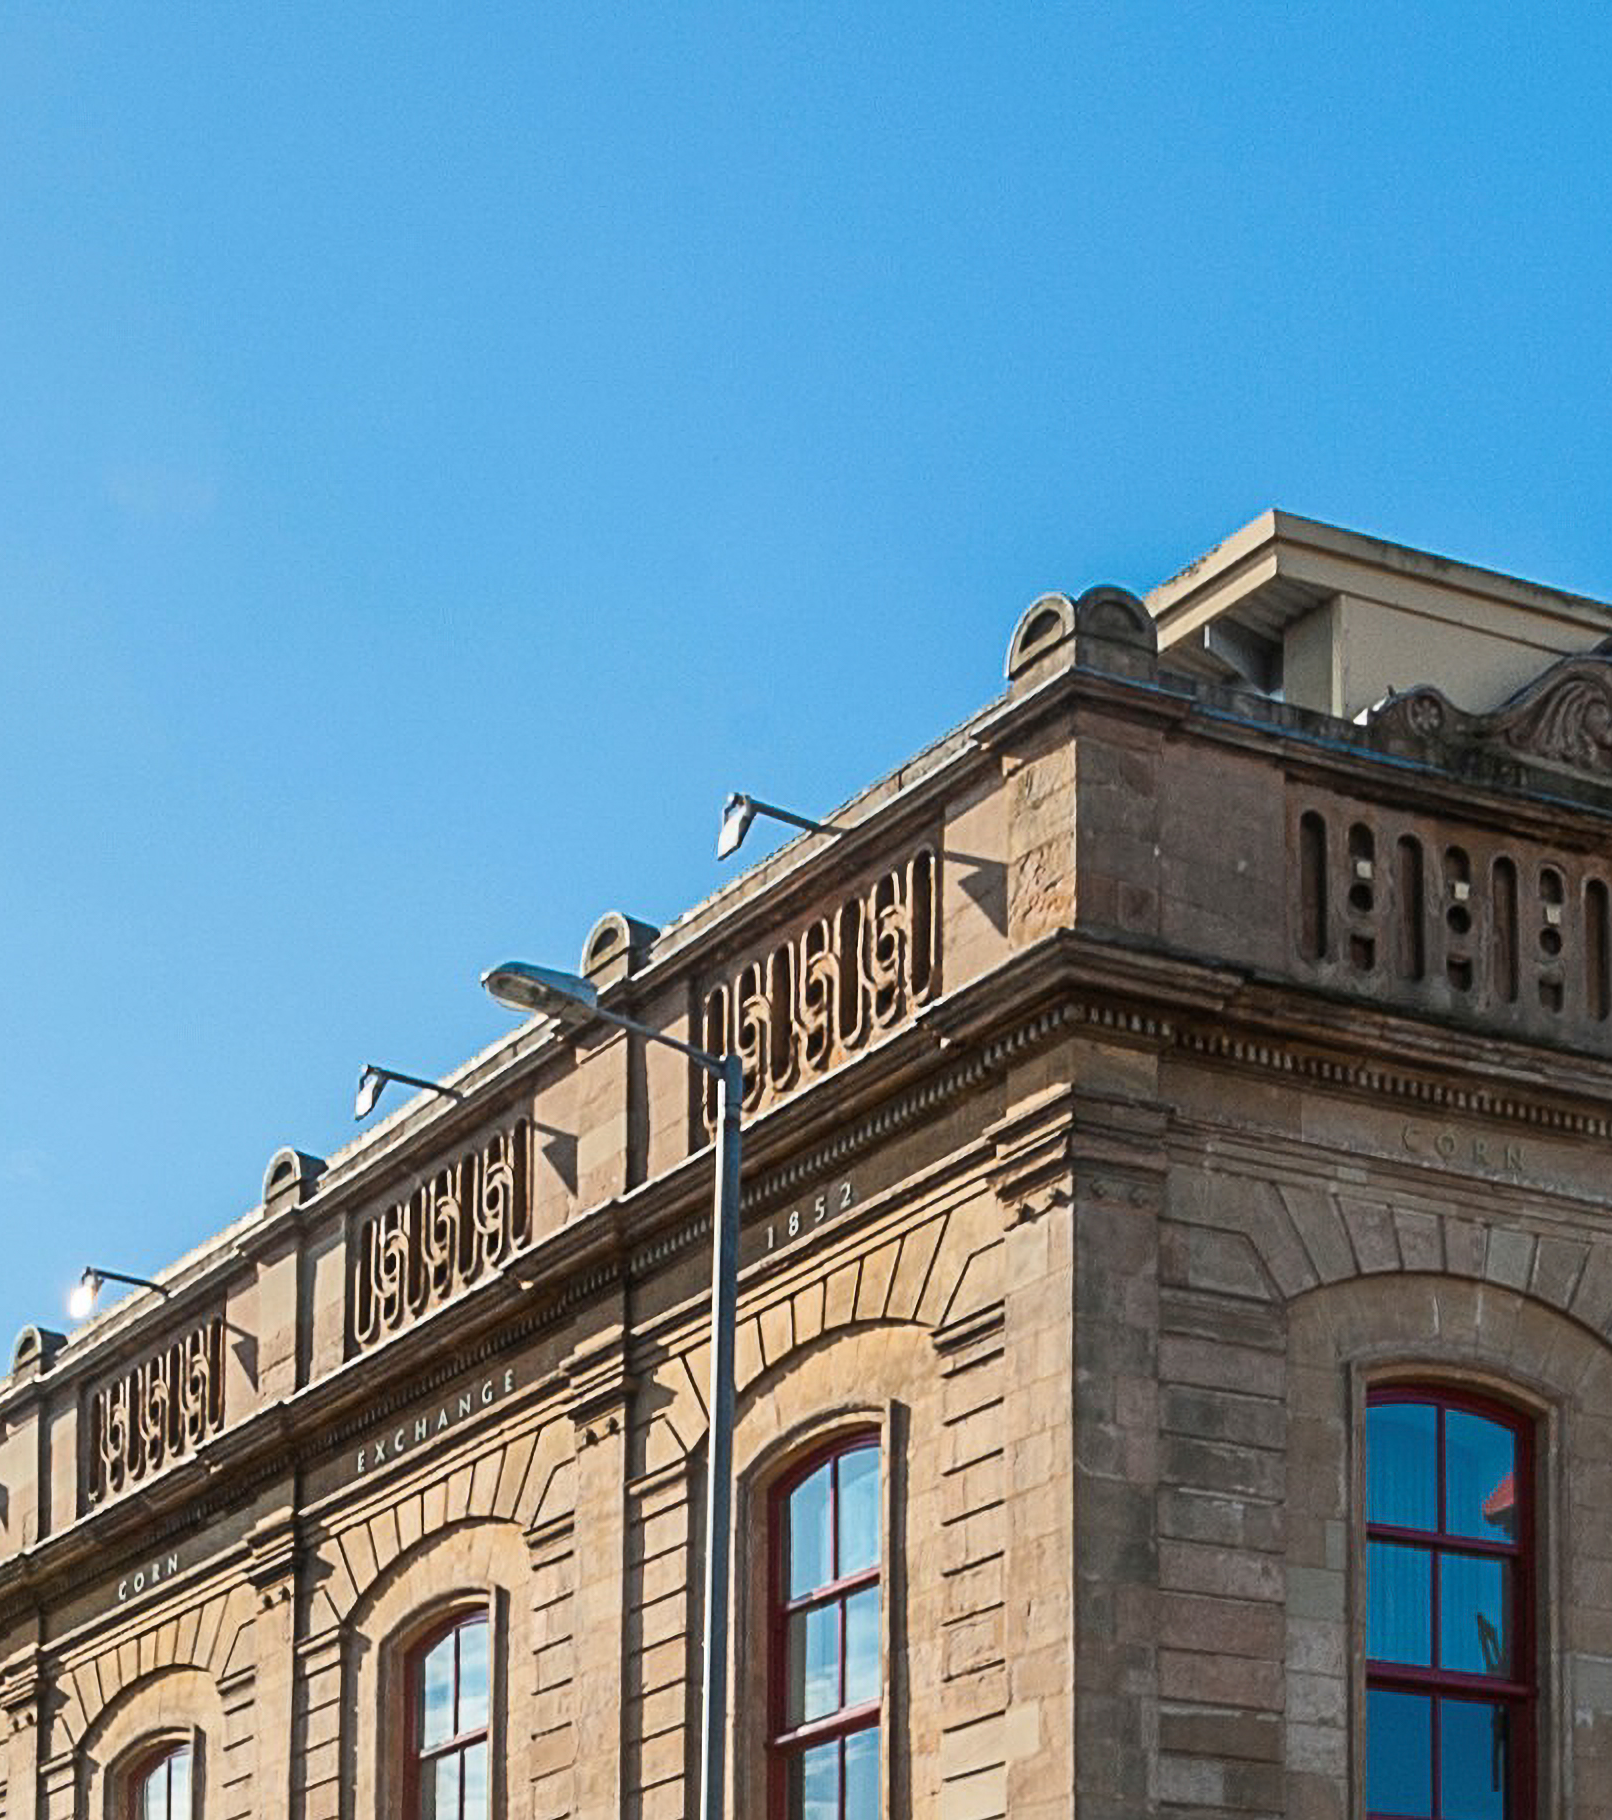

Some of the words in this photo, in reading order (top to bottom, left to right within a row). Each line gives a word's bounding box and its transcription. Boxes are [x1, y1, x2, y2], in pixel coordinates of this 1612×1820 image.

[1400, 1123, 1523, 1171] CORN
[767, 1182, 852, 1249] 1852
[118, 1553, 178, 1600] CORN
[357, 1368, 514, 1473] EXCHANGE
